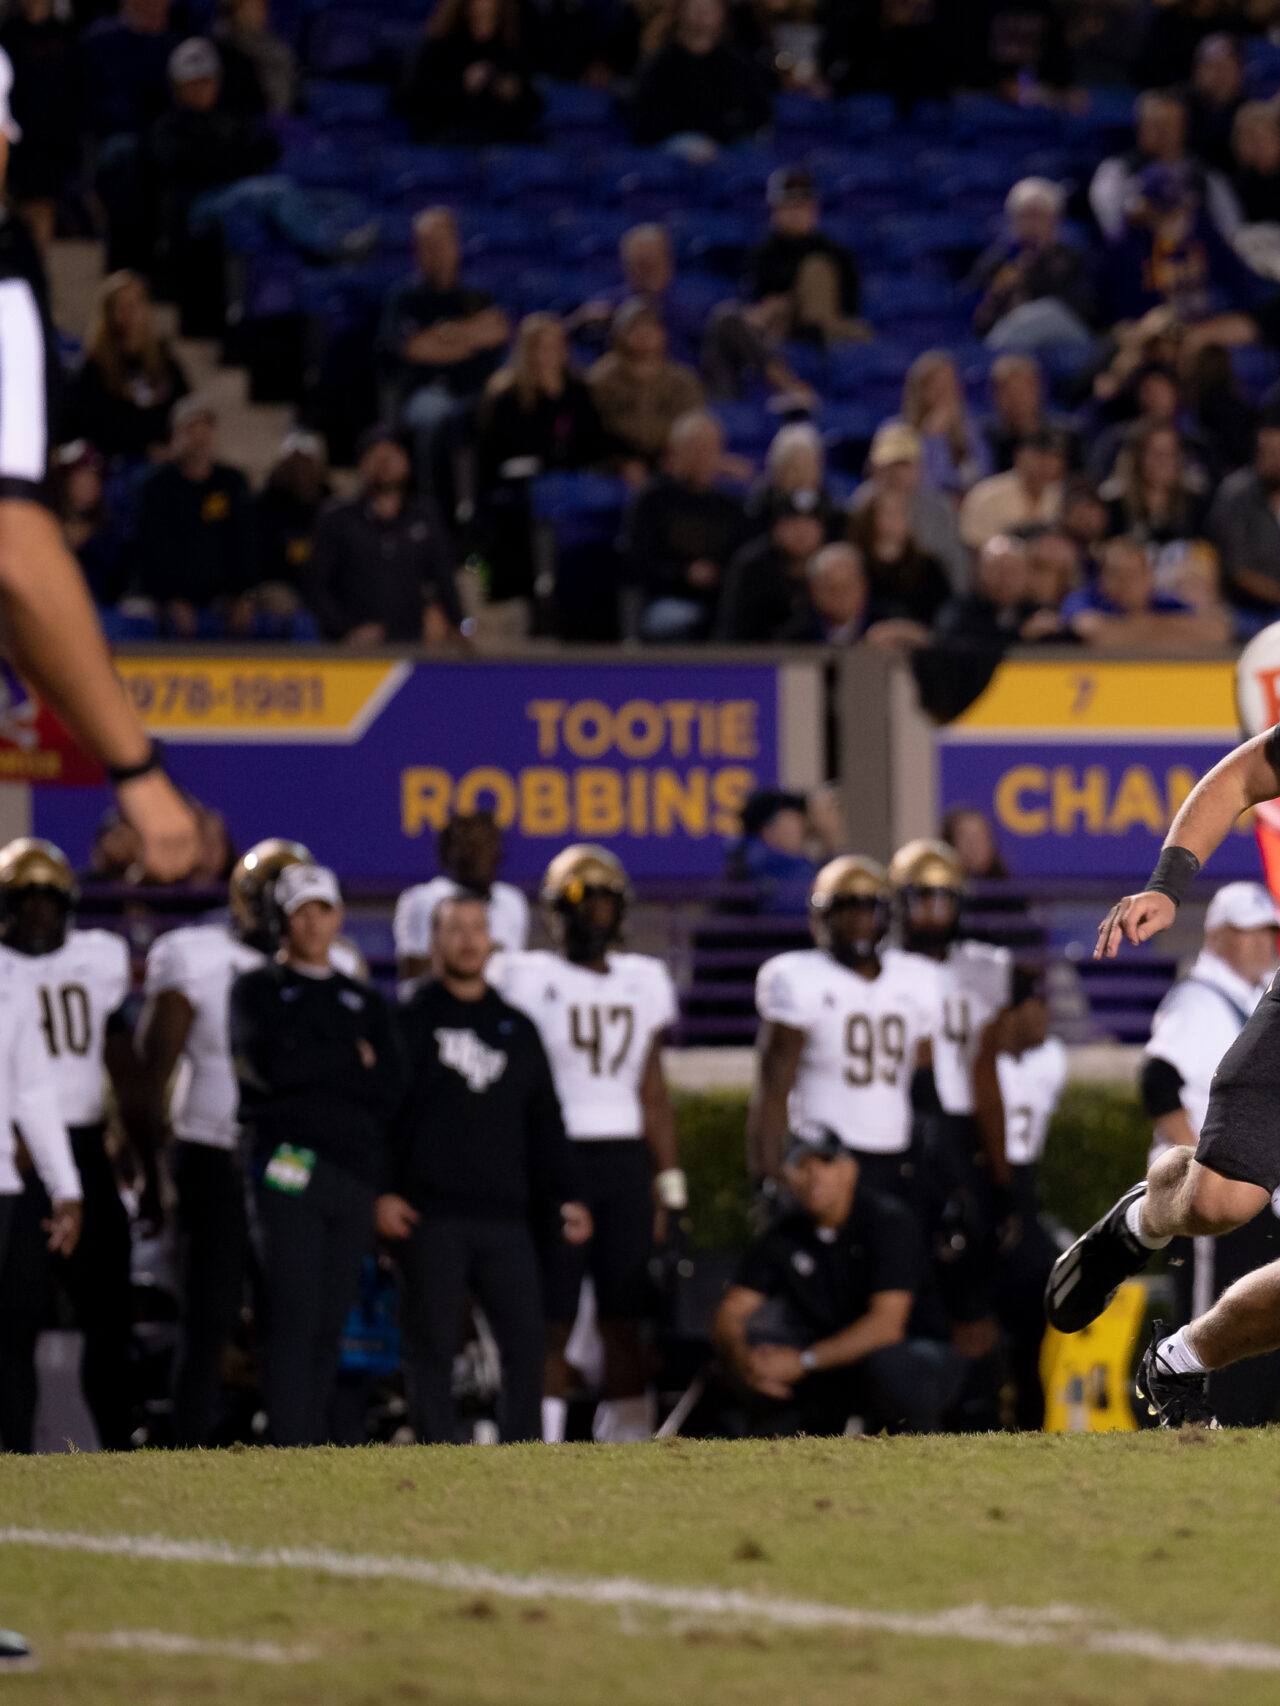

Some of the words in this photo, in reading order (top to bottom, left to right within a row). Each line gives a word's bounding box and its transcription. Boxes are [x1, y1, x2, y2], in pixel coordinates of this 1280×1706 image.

[126, 673, 325, 717] 978-1981
[526, 699, 758, 759] TOOTIE
[401, 766, 756, 838] ROBBINS
[570, 1004, 634, 1078] 47
[844, 1013, 905, 1088] 99
